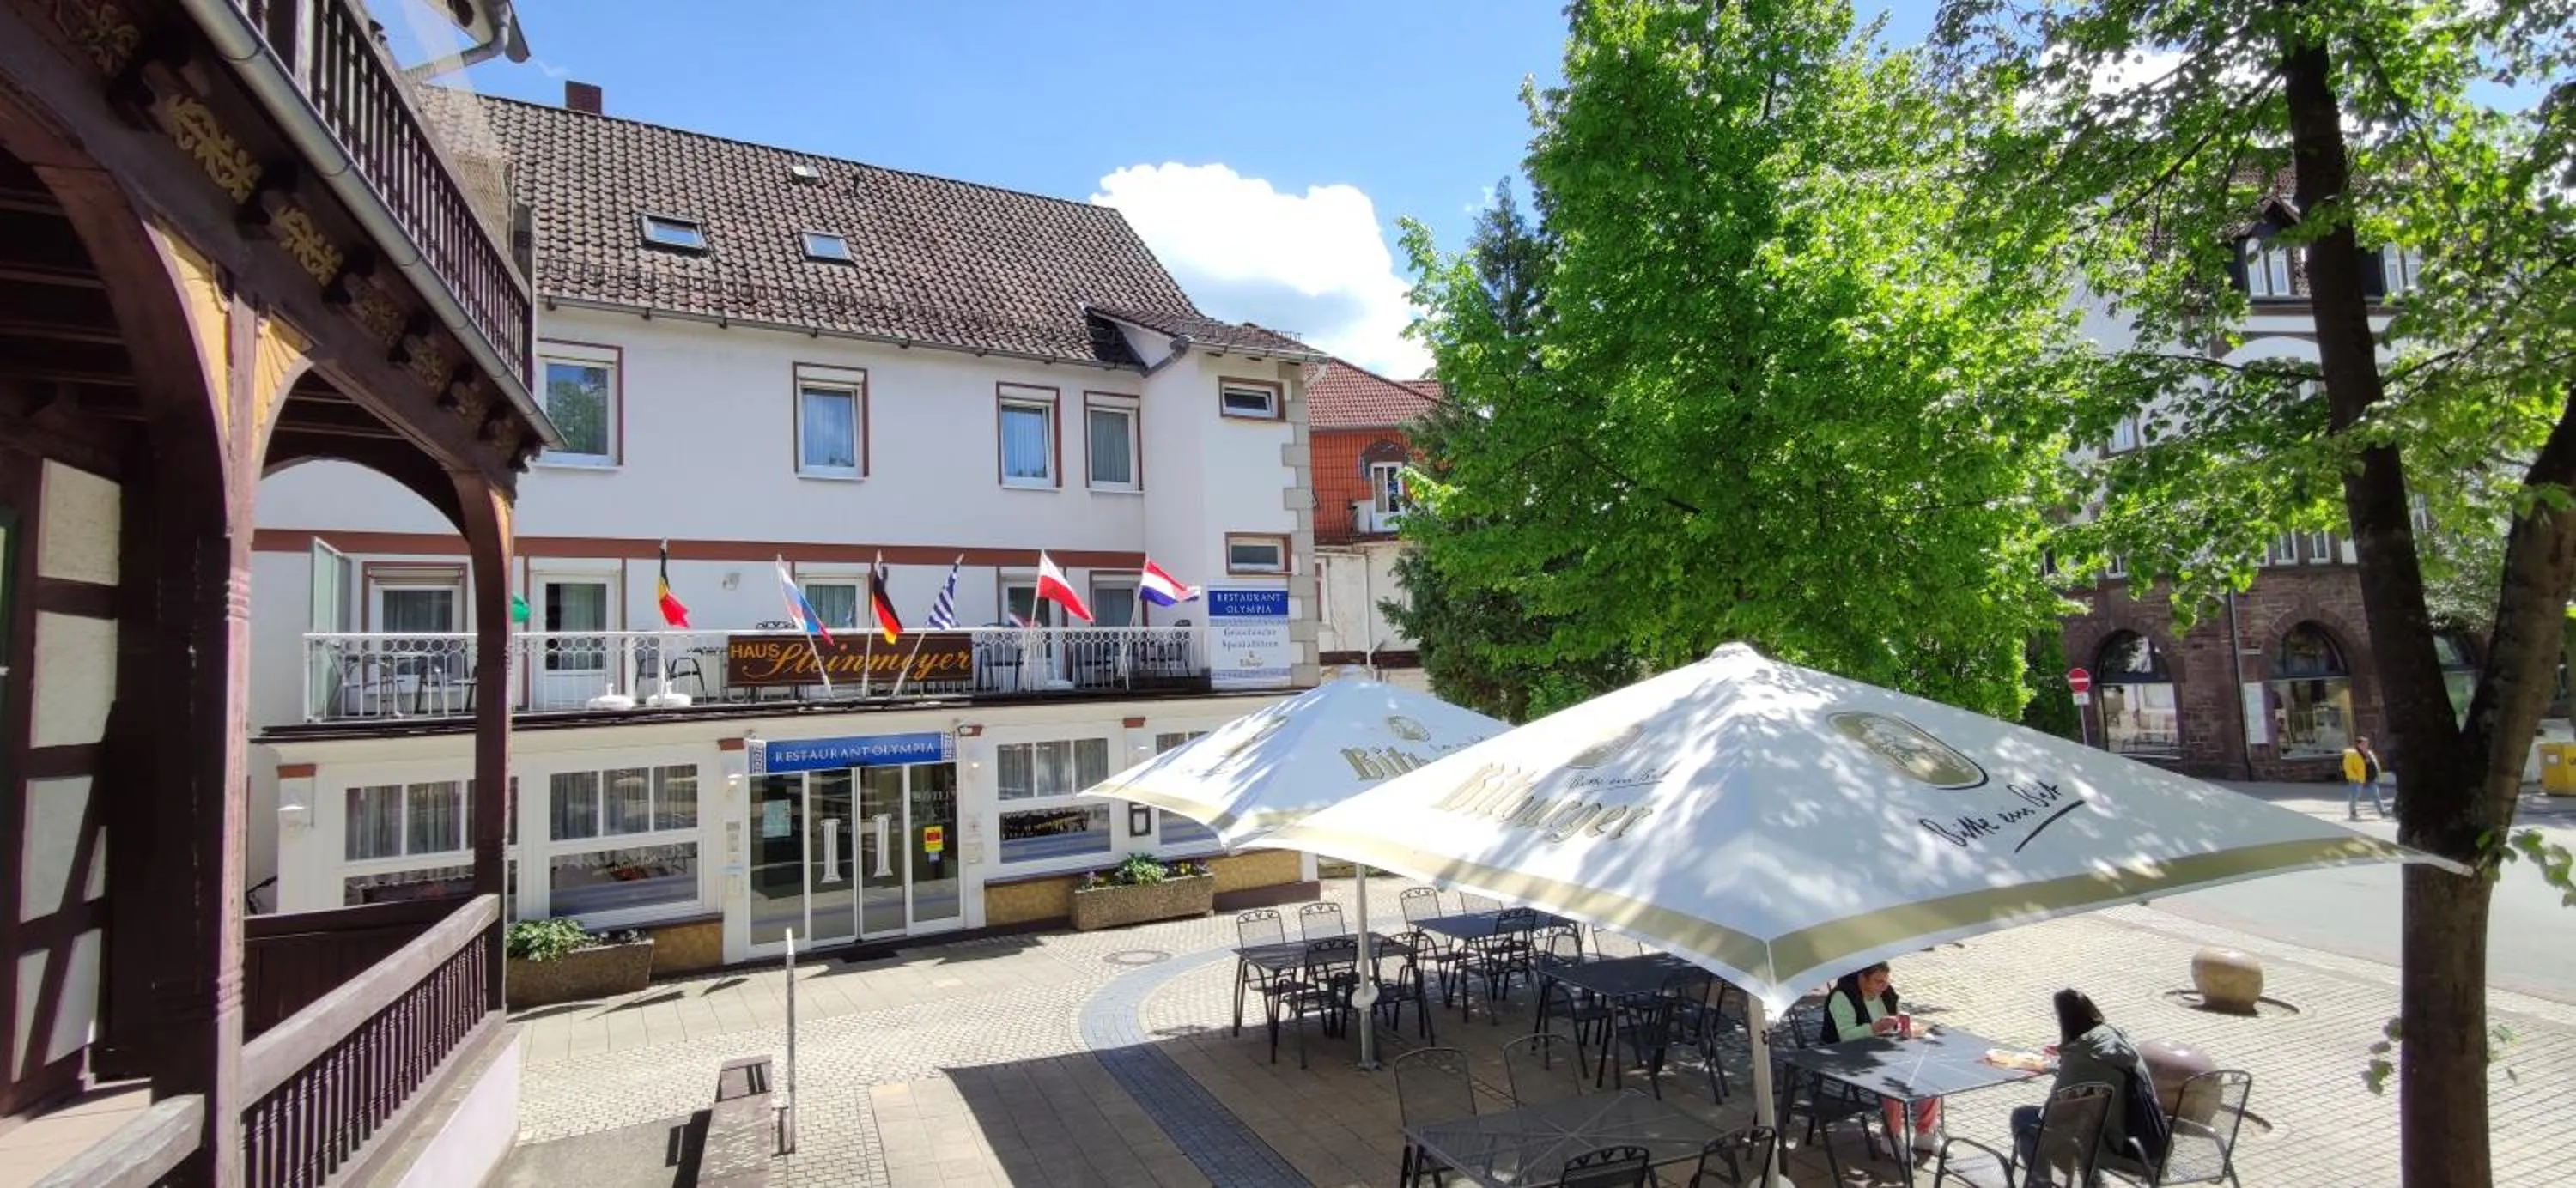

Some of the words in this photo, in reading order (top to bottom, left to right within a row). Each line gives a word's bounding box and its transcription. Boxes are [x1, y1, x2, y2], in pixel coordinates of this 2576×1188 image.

[1217, 592, 1281, 603] RESTAURANT
[1224, 604, 1273, 615] OLYMPIA
[730, 643, 781, 659] HAUS
[775, 745, 870, 763] RESTAURANT
[872, 742, 935, 756] OLYMPIA
[1918, 815, 2000, 846] Bitte
